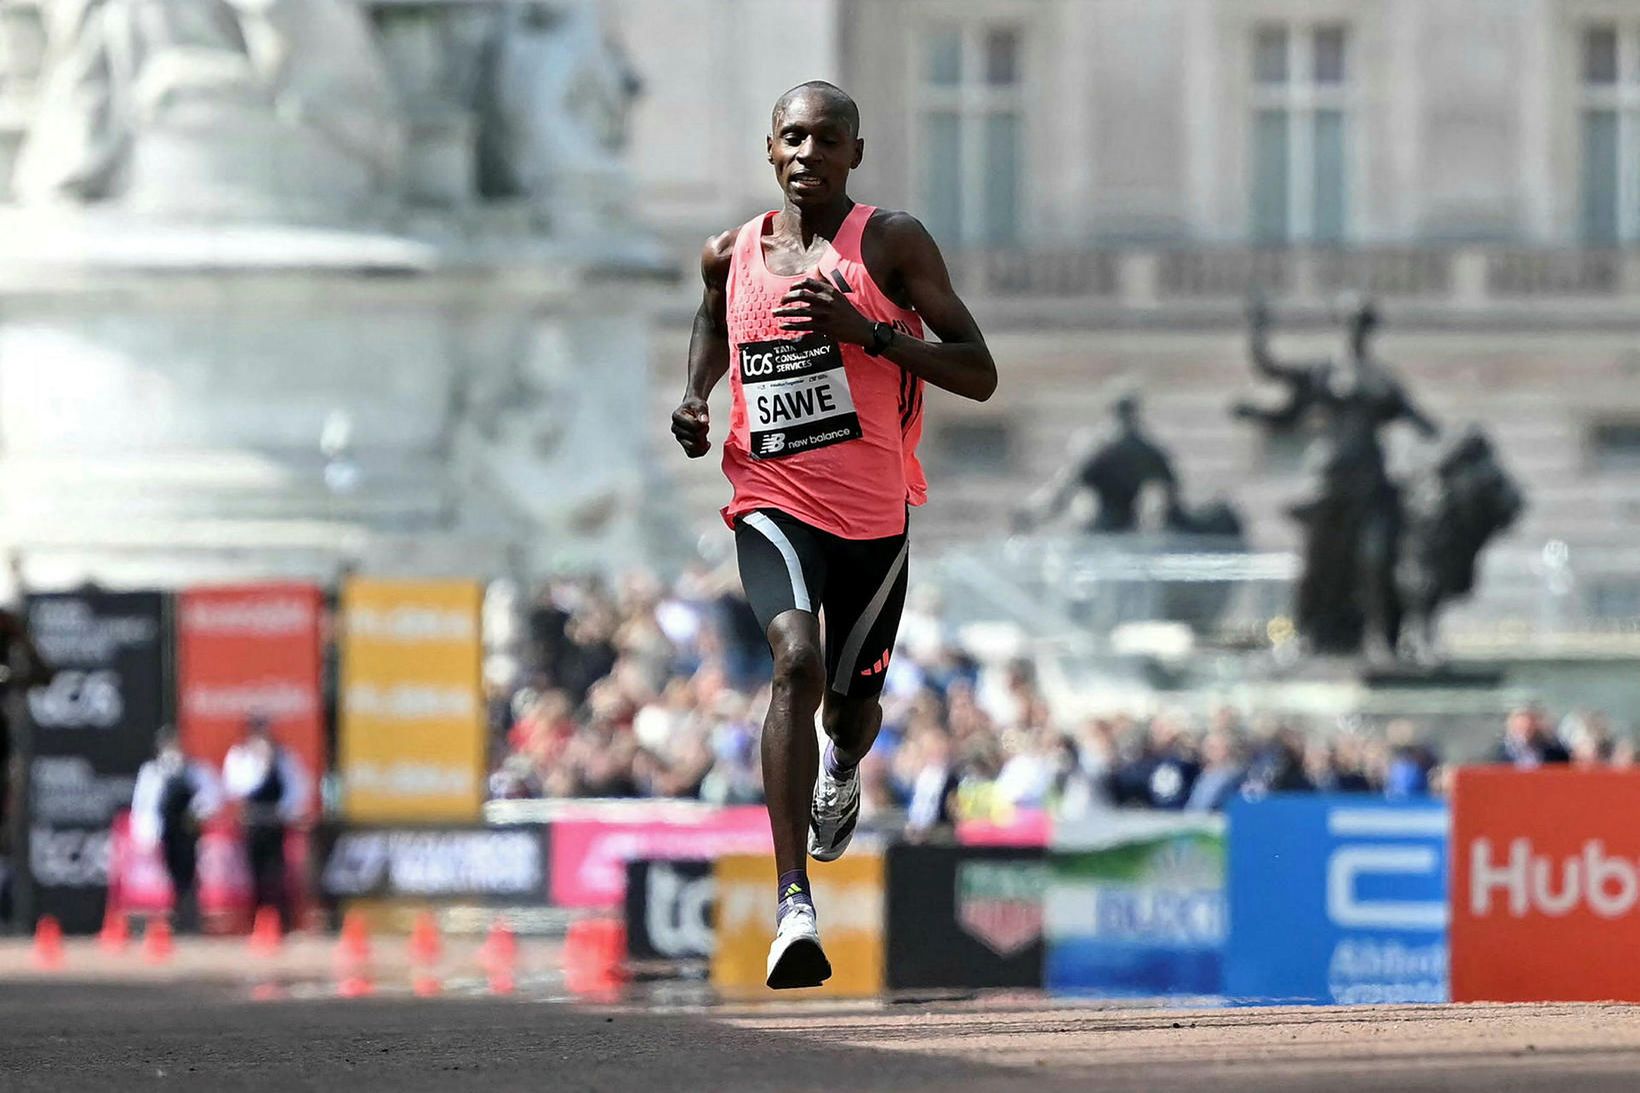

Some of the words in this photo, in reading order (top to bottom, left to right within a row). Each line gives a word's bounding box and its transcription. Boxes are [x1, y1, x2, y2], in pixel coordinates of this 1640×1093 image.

[742, 347, 773, 376] tcs
[776, 360, 812, 373] SERVICES
[757, 384, 836, 424] SAWE
[788, 438, 808, 449] new
[809, 428, 850, 443] balance
[1469, 836, 1639, 919] Hub
